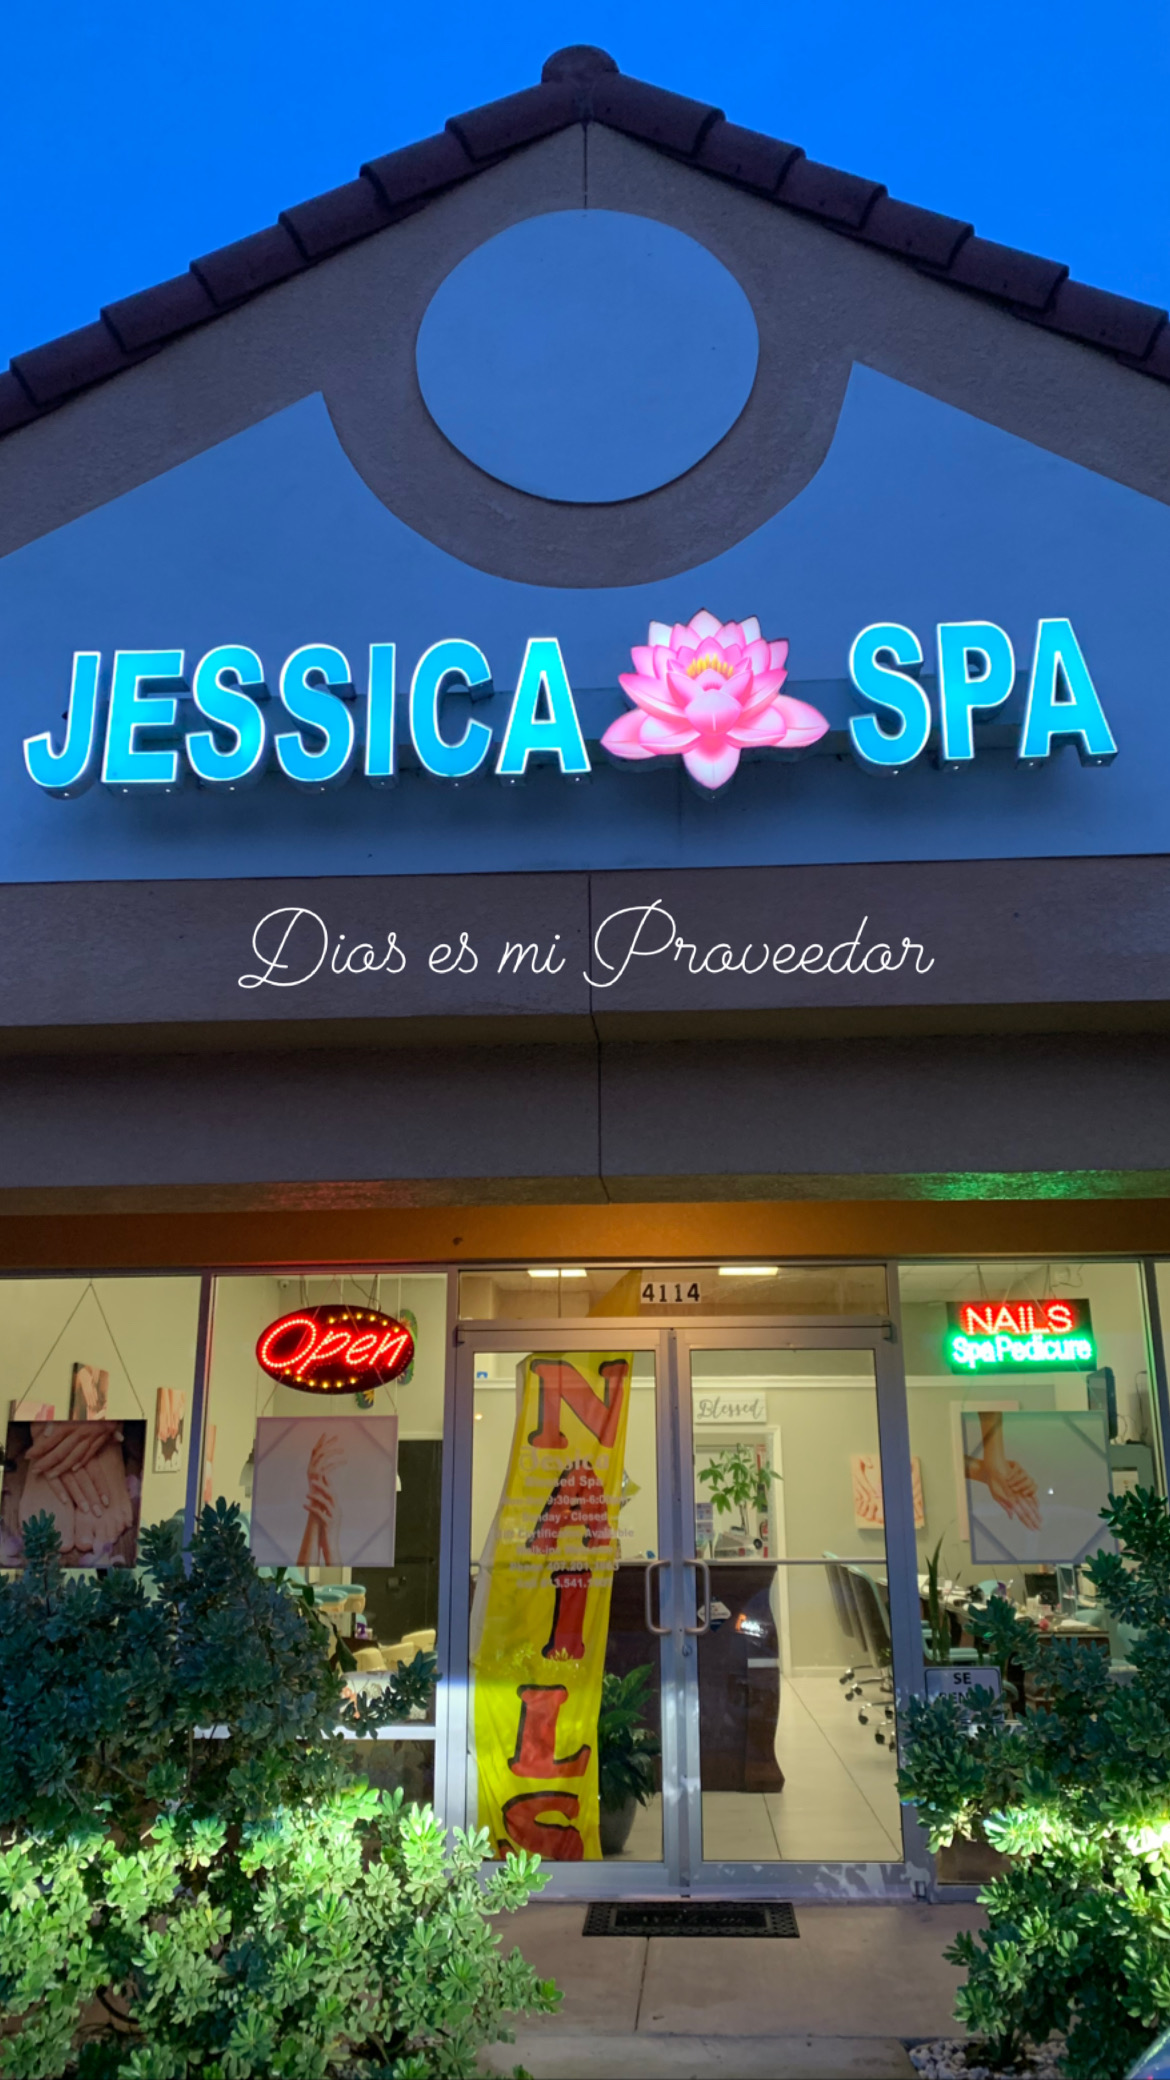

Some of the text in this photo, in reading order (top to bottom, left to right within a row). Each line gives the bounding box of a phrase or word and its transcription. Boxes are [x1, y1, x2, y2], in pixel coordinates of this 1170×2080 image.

[23, 616, 1119, 789] JESSICA SPA
[642, 1283, 700, 1302] 4114
[964, 1304, 1073, 1336] NAILS
[261, 1318, 409, 1374] Open
[697, 1396, 764, 1419] Blessed
[579, 1475, 604, 1489] Spa
[523, 1511, 561, 1522] nday
[570, 1511, 608, 1522] Closed
[953, 1671, 972, 1685] SE
